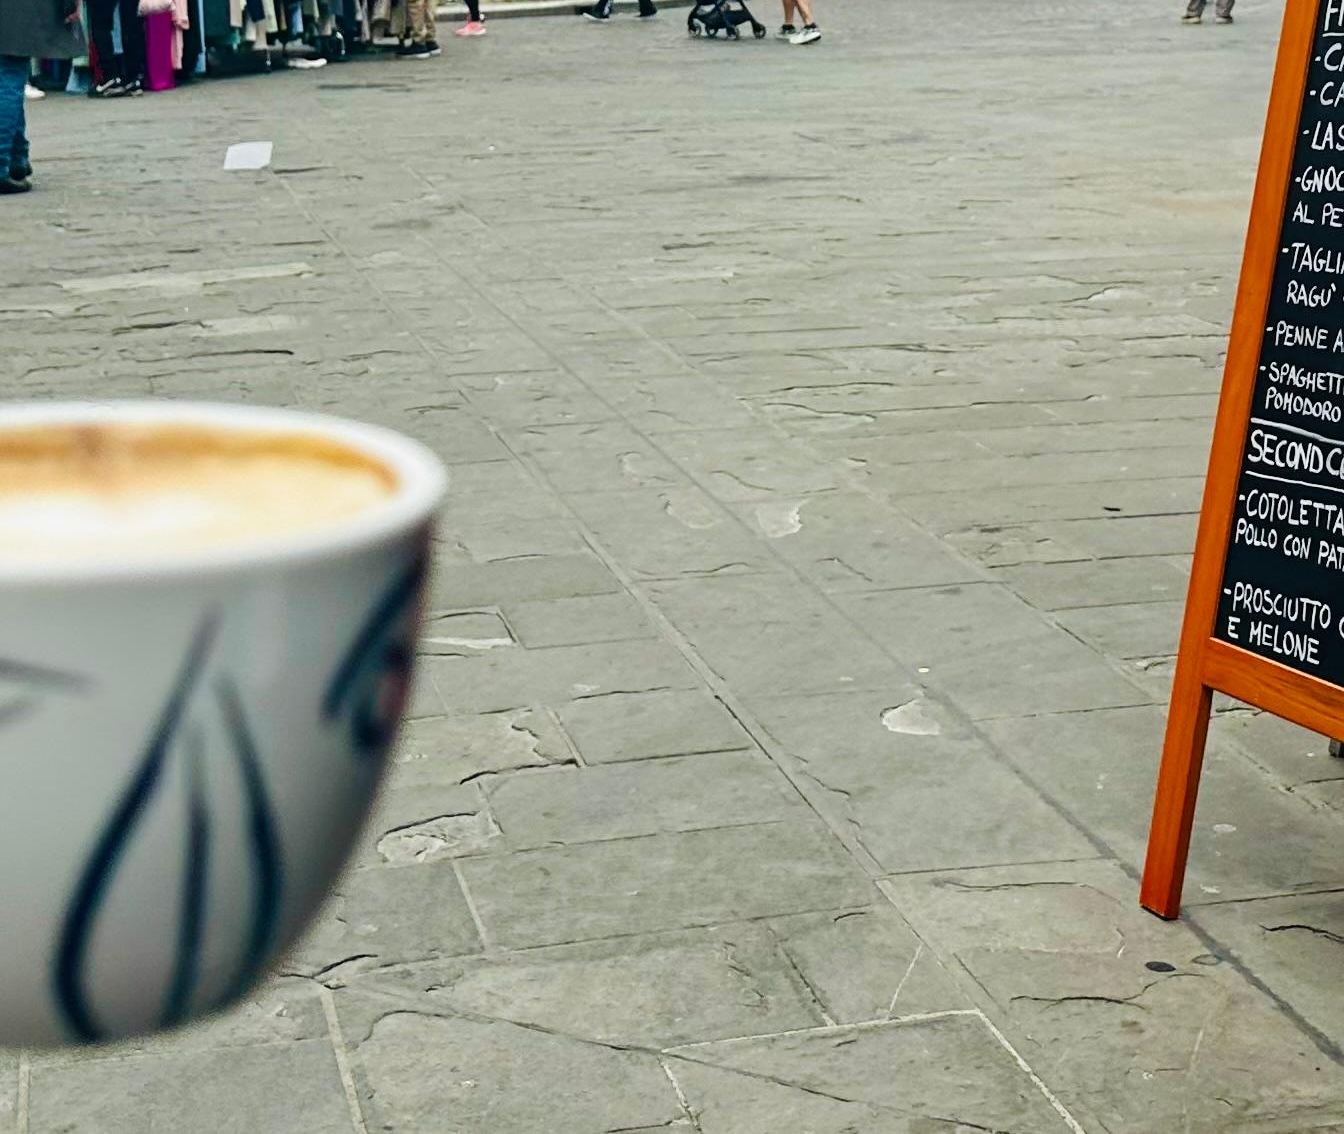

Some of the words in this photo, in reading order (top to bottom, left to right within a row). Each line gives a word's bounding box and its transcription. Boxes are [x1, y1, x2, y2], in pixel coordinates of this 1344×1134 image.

[1292, 201, 1314, 224] AL
[1264, 386, 1342, 423] POMODORO
[1247, 429, 1324, 474] SECOND
[1234, 517, 1278, 549] POLLO
[1283, 534, 1311, 560] CON
[1227, 616, 1241, 640] E
[1248, 620, 1321, 665] MELONE
